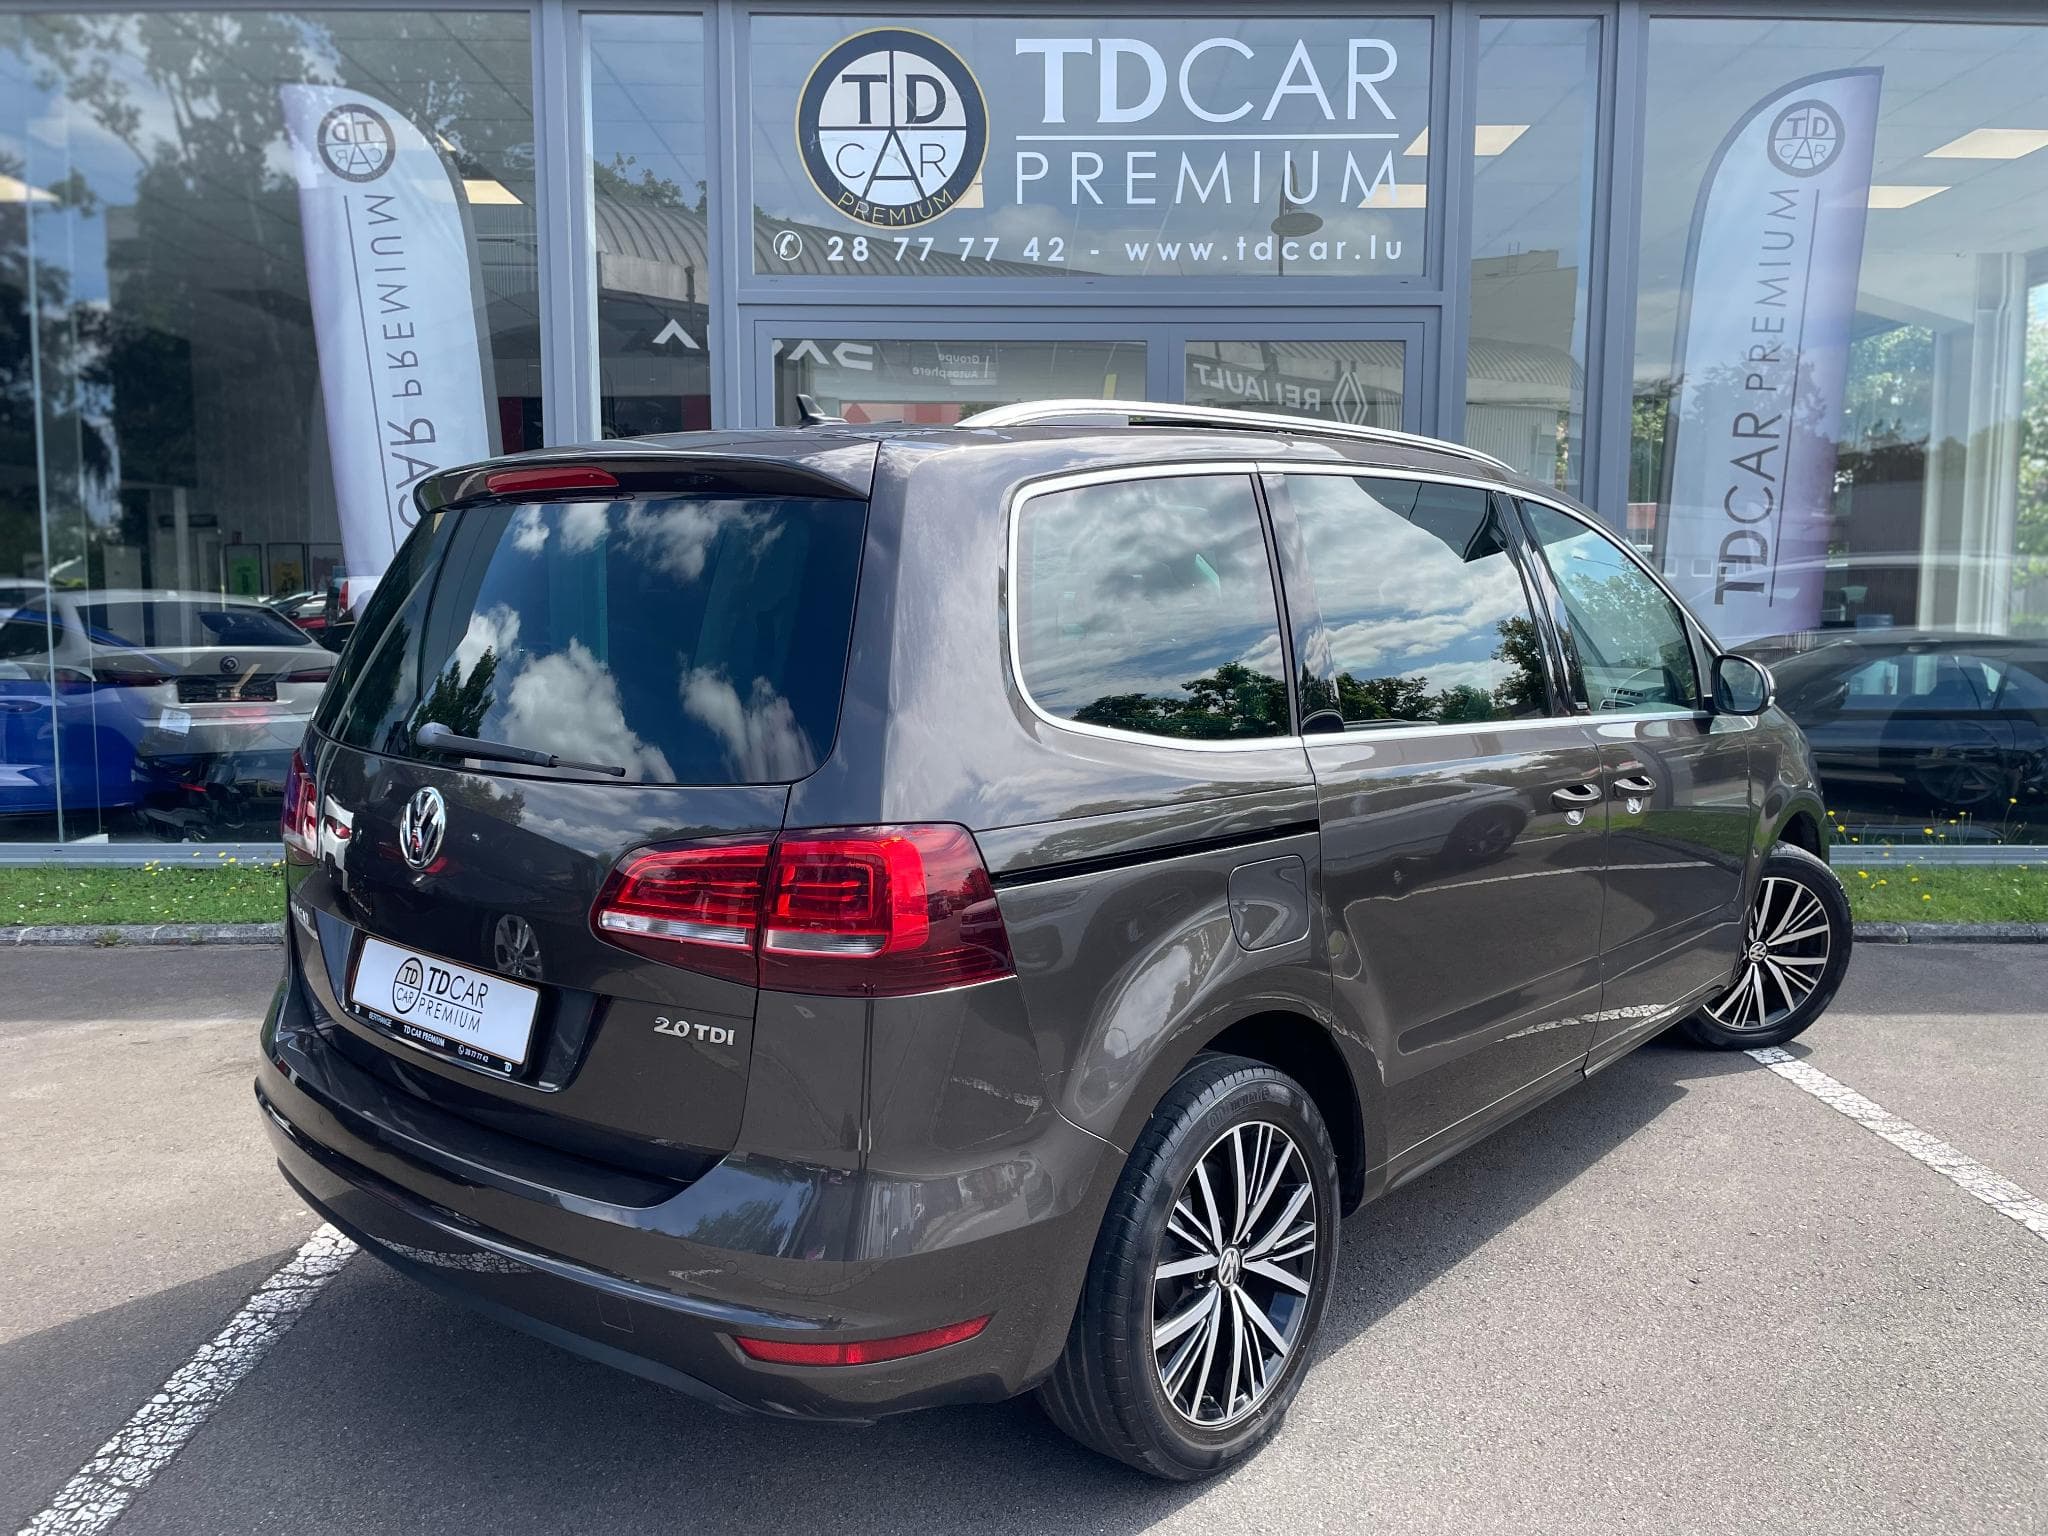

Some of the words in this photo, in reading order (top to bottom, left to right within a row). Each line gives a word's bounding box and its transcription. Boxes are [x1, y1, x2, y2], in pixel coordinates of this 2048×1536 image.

[1015, 38, 1397, 123] TDCAR
[835, 126, 948, 200] CAR
[1016, 149, 1399, 206] PREMIUM
[837, 188, 954, 226] PREMIUM
[827, 236, 869, 262] 28
[893, 237, 935, 262] 77
[958, 237, 1000, 262] 77
[1023, 236, 1065, 262] 42
[1124, 234, 1402, 261] www.tdcar.lu
[1744, 187, 1800, 392] PREMIUM
[1714, 411, 1783, 606] TDCAR
[426, 966, 489, 1009] TDCAR
[417, 997, 481, 1033] PREMIUM
[693, 1023, 736, 1046] TDI
